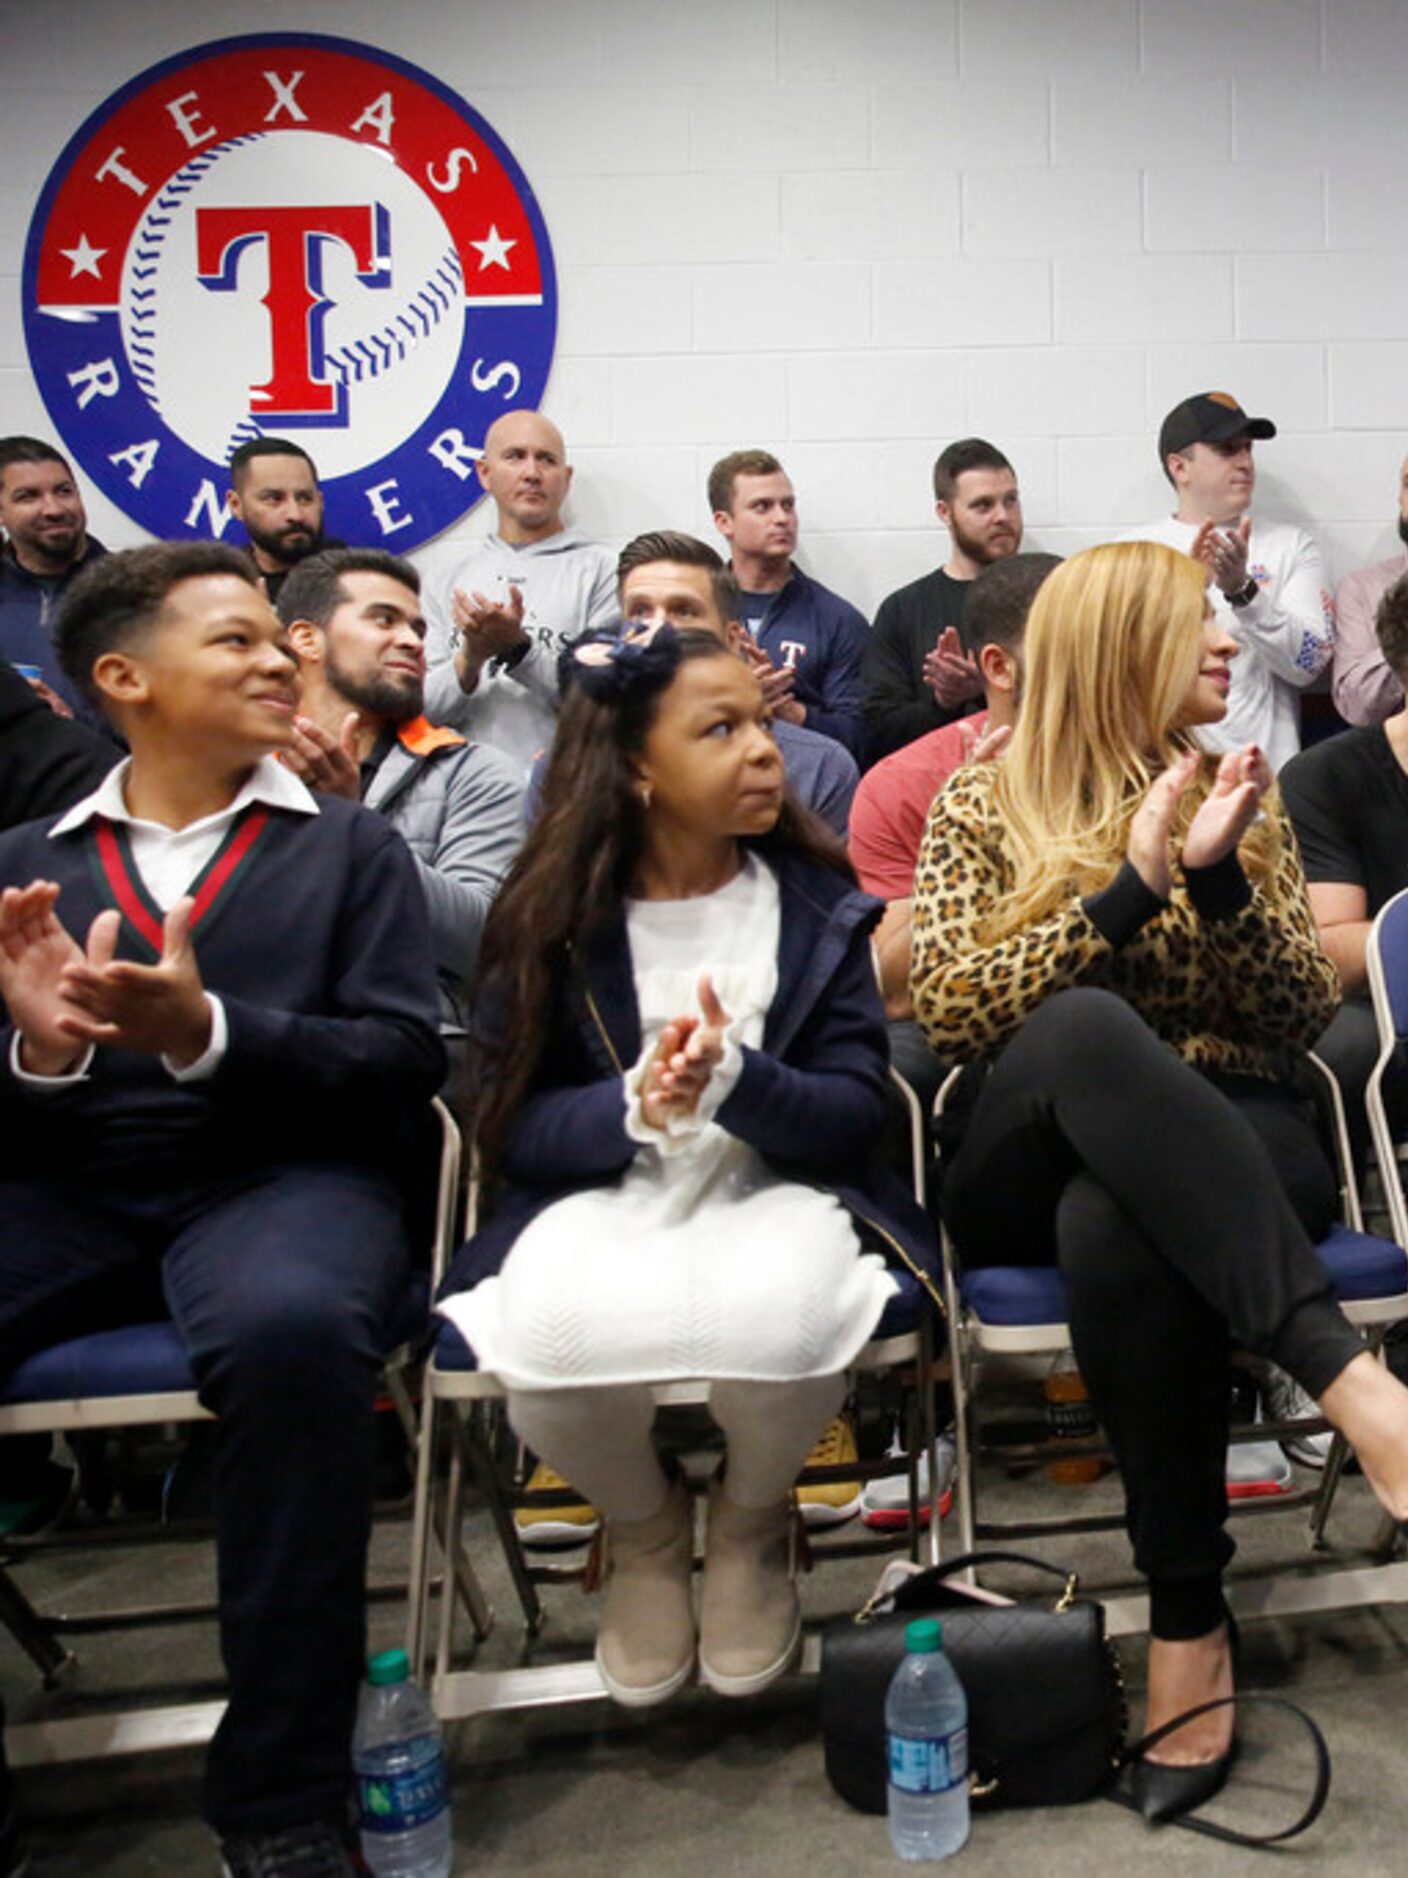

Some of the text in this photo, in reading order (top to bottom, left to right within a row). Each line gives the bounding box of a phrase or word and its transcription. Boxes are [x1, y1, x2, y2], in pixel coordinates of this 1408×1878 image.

[95, 71, 478, 197] TEXAS
[195, 201, 392, 429] T
[67, 358, 522, 539] RANERS
[780, 640, 807, 672] T
